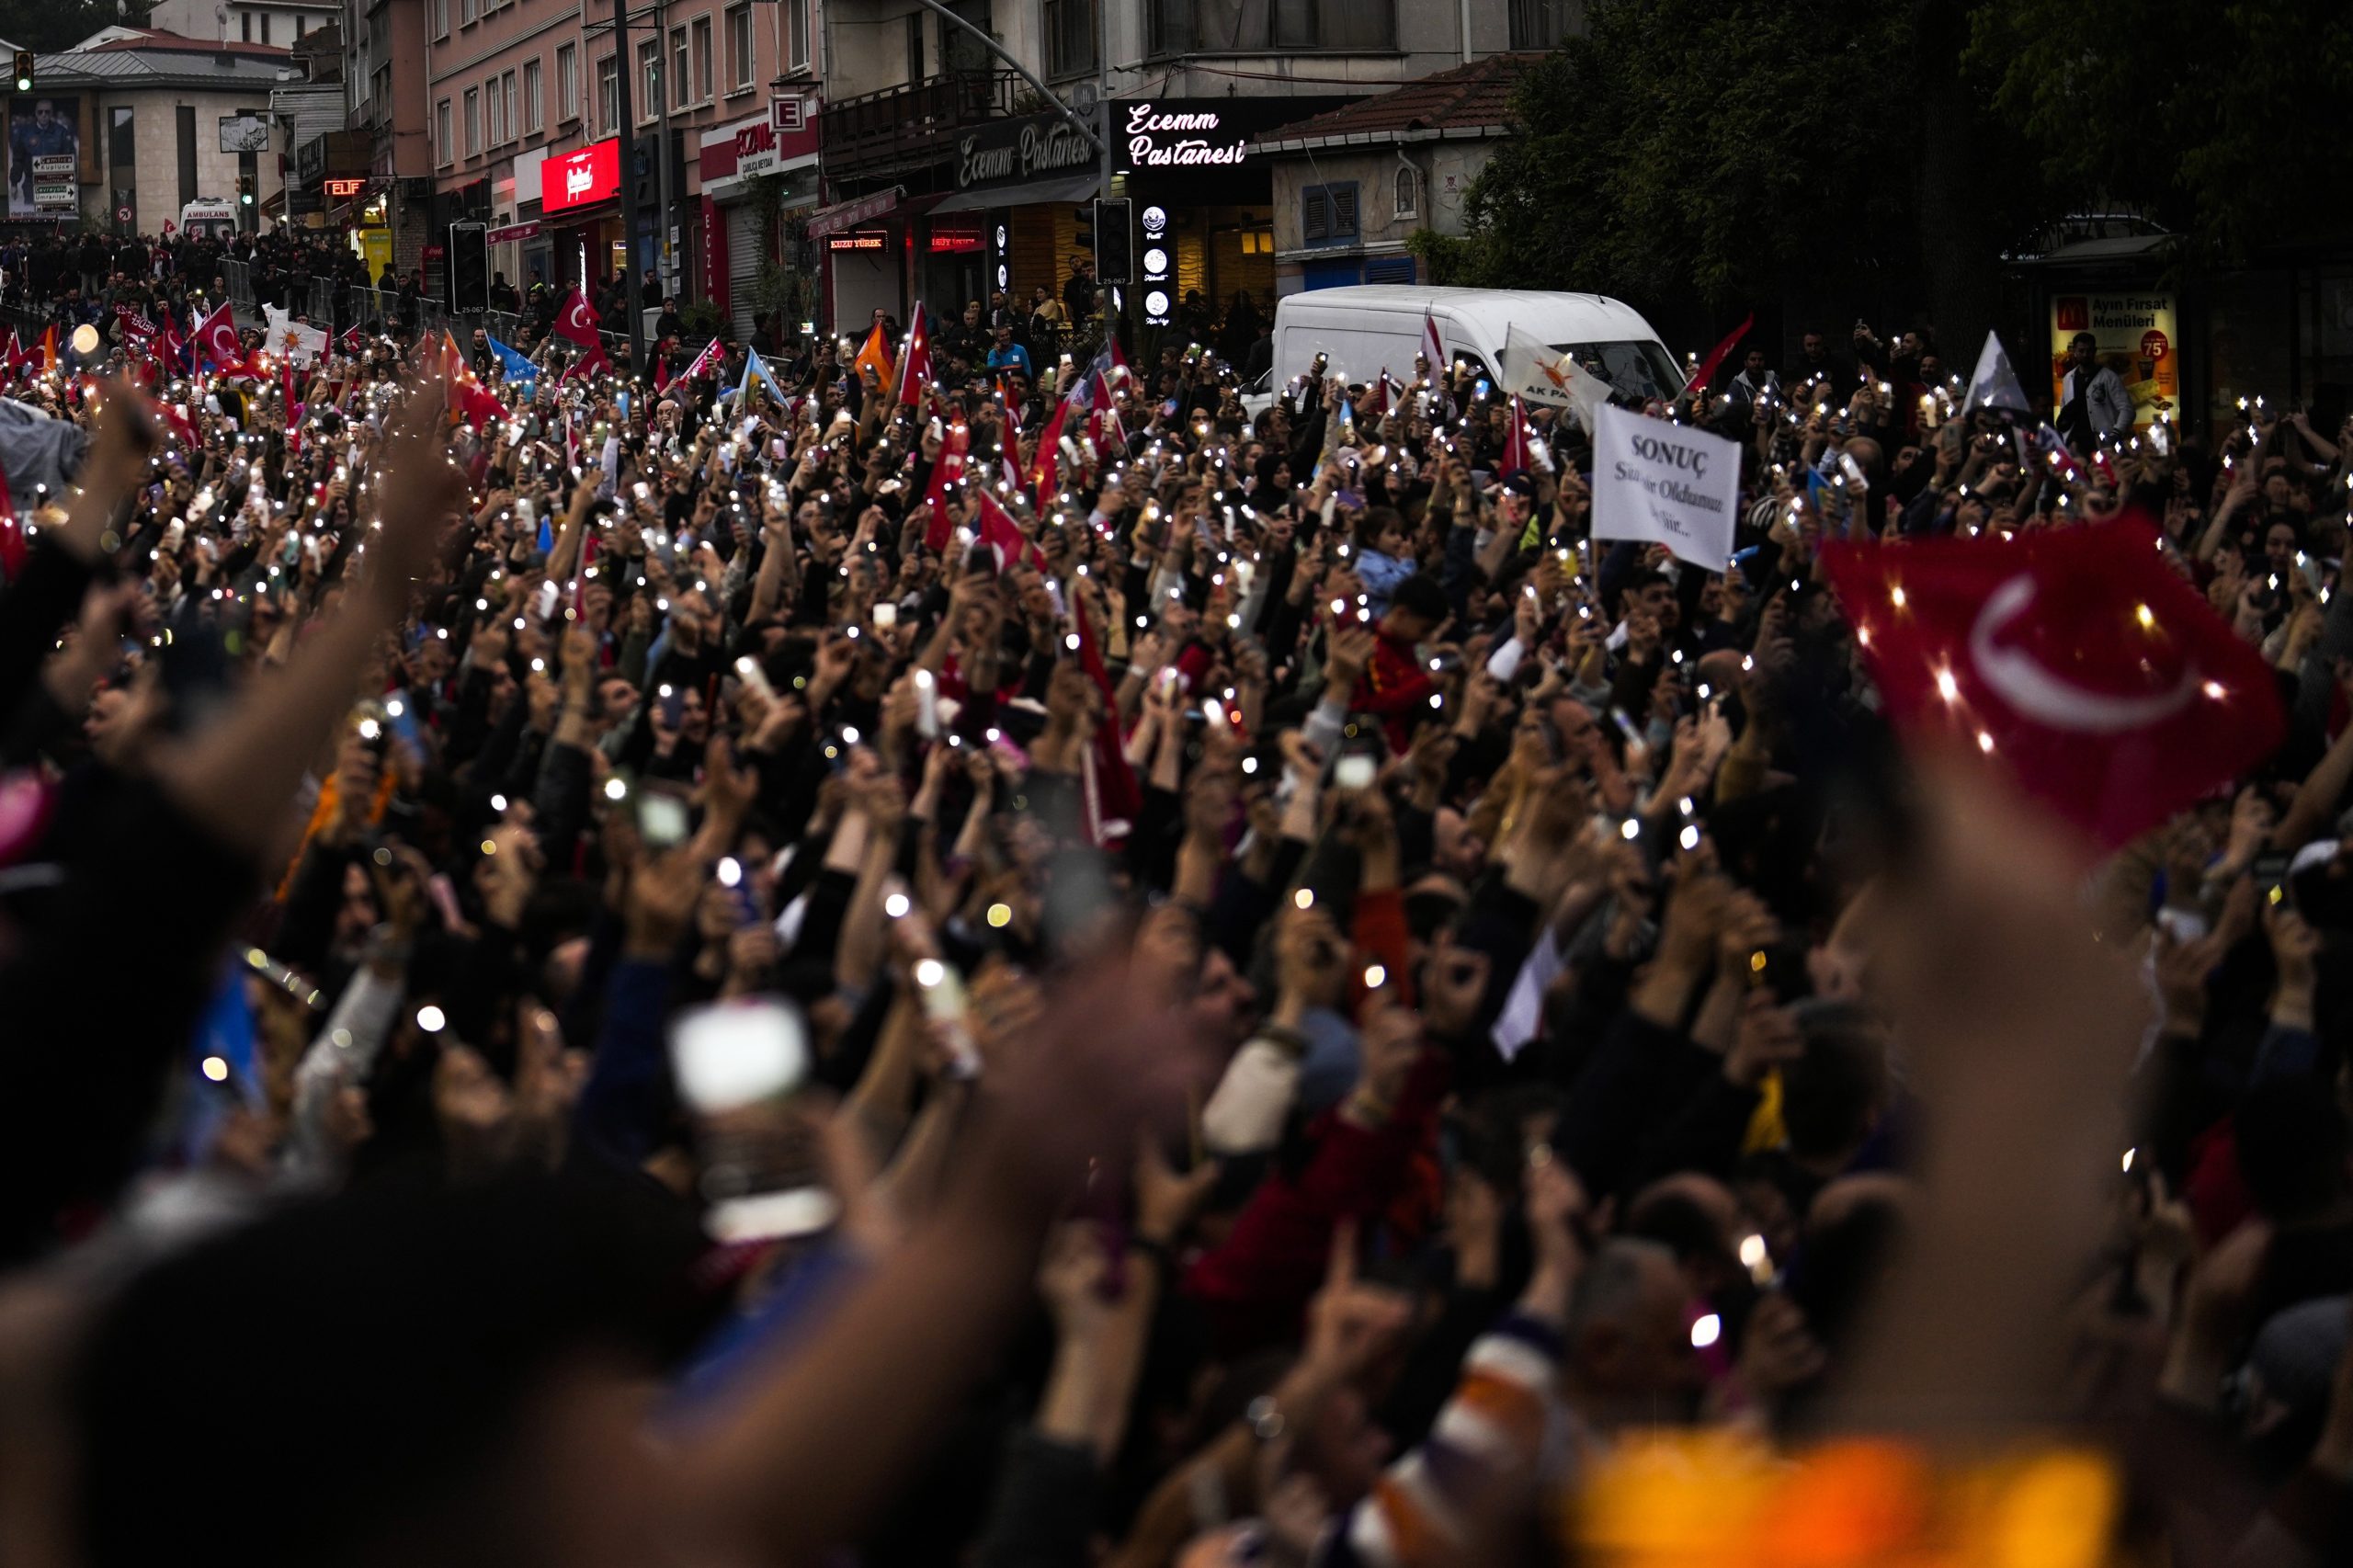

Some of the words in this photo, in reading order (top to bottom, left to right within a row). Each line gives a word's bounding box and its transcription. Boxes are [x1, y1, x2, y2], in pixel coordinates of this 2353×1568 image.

[779, 103, 798, 124] E
[1126, 104, 1219, 134] Ecemm
[960, 137, 1014, 187] Ecemm
[1020, 120, 1094, 177] Pastanesi
[1129, 135, 1246, 165] Pastanesi
[187, 210, 230, 219] AMBULANS
[2092, 298, 2123, 314] Ayın
[2127, 298, 2167, 311] Fırsat
[2092, 313, 2155, 328] Menüleri
[2144, 342, 2163, 357] 75
[1526, 385, 1546, 396] AK
[1631, 434, 1709, 480] SONUÇ
